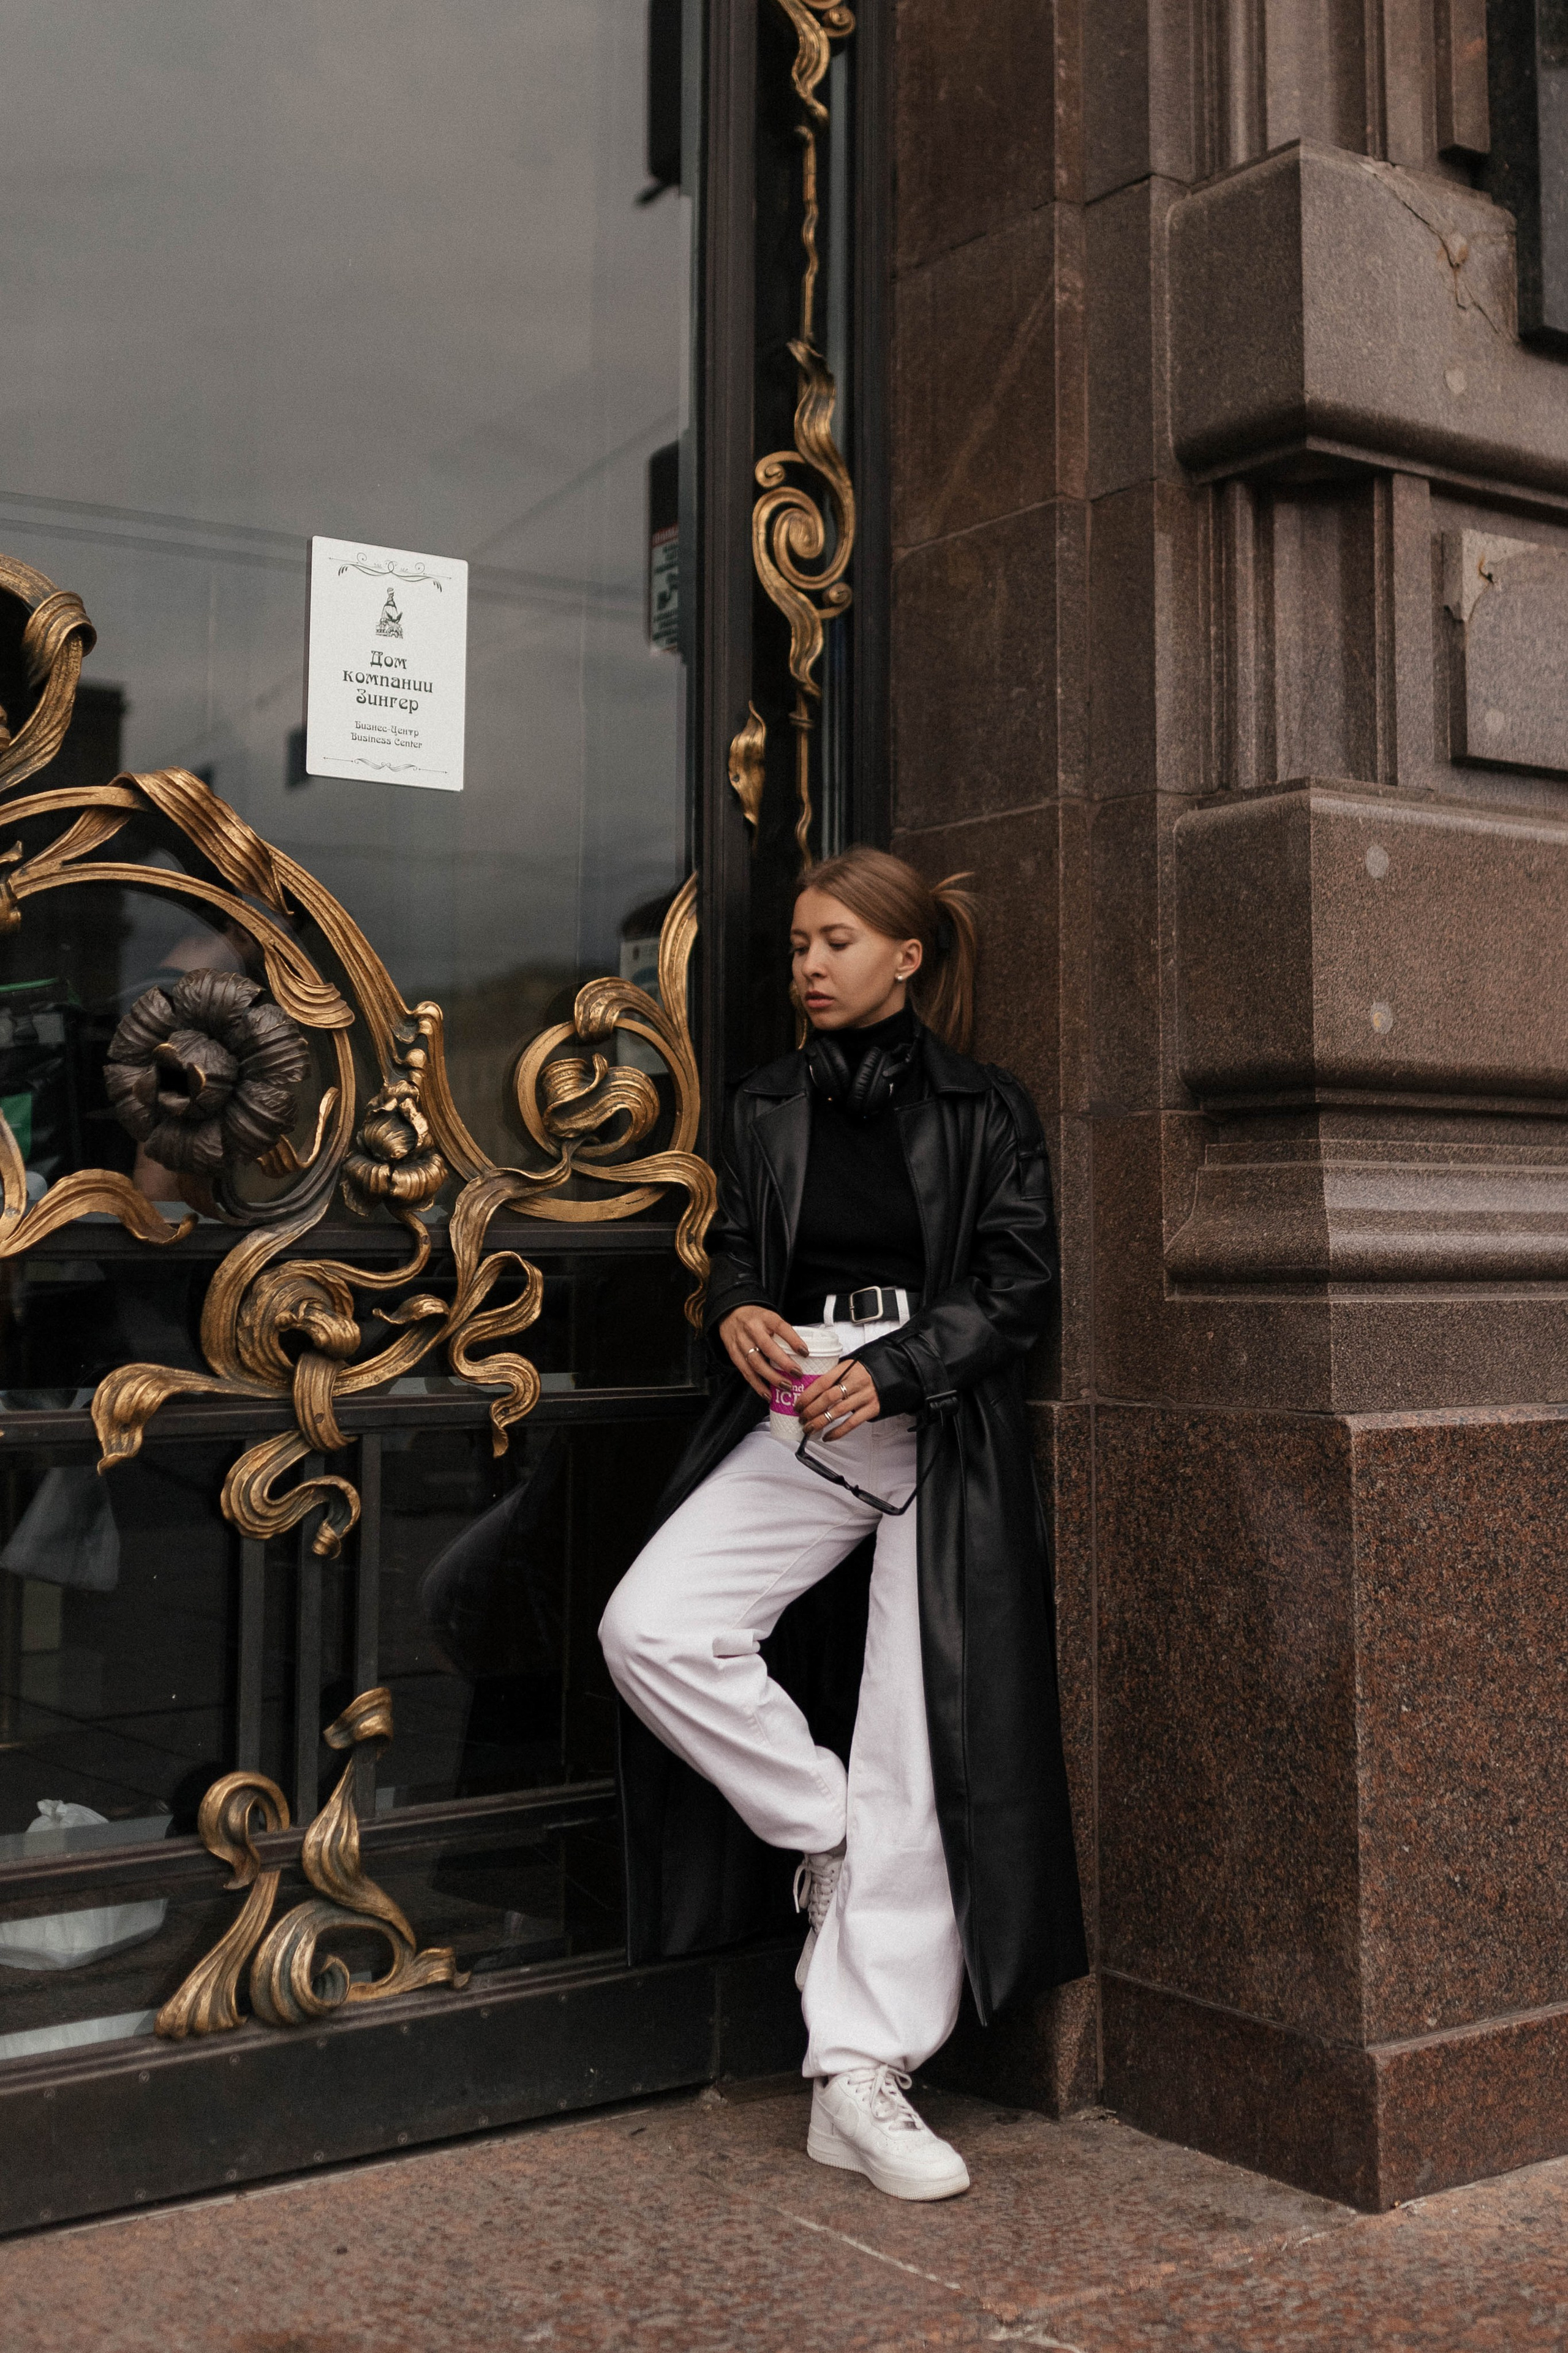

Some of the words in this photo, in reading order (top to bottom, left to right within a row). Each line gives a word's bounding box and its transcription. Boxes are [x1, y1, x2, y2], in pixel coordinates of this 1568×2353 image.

[370, 650, 407, 670] Дом
[342, 670, 433, 693] компании
[356, 689, 419, 714] Зингер
[355, 720, 419, 738] Бизнес-Центр
[350, 732, 391, 745] Business
[394, 738, 423, 749] Center
[792, 1383, 805, 1392] nd
